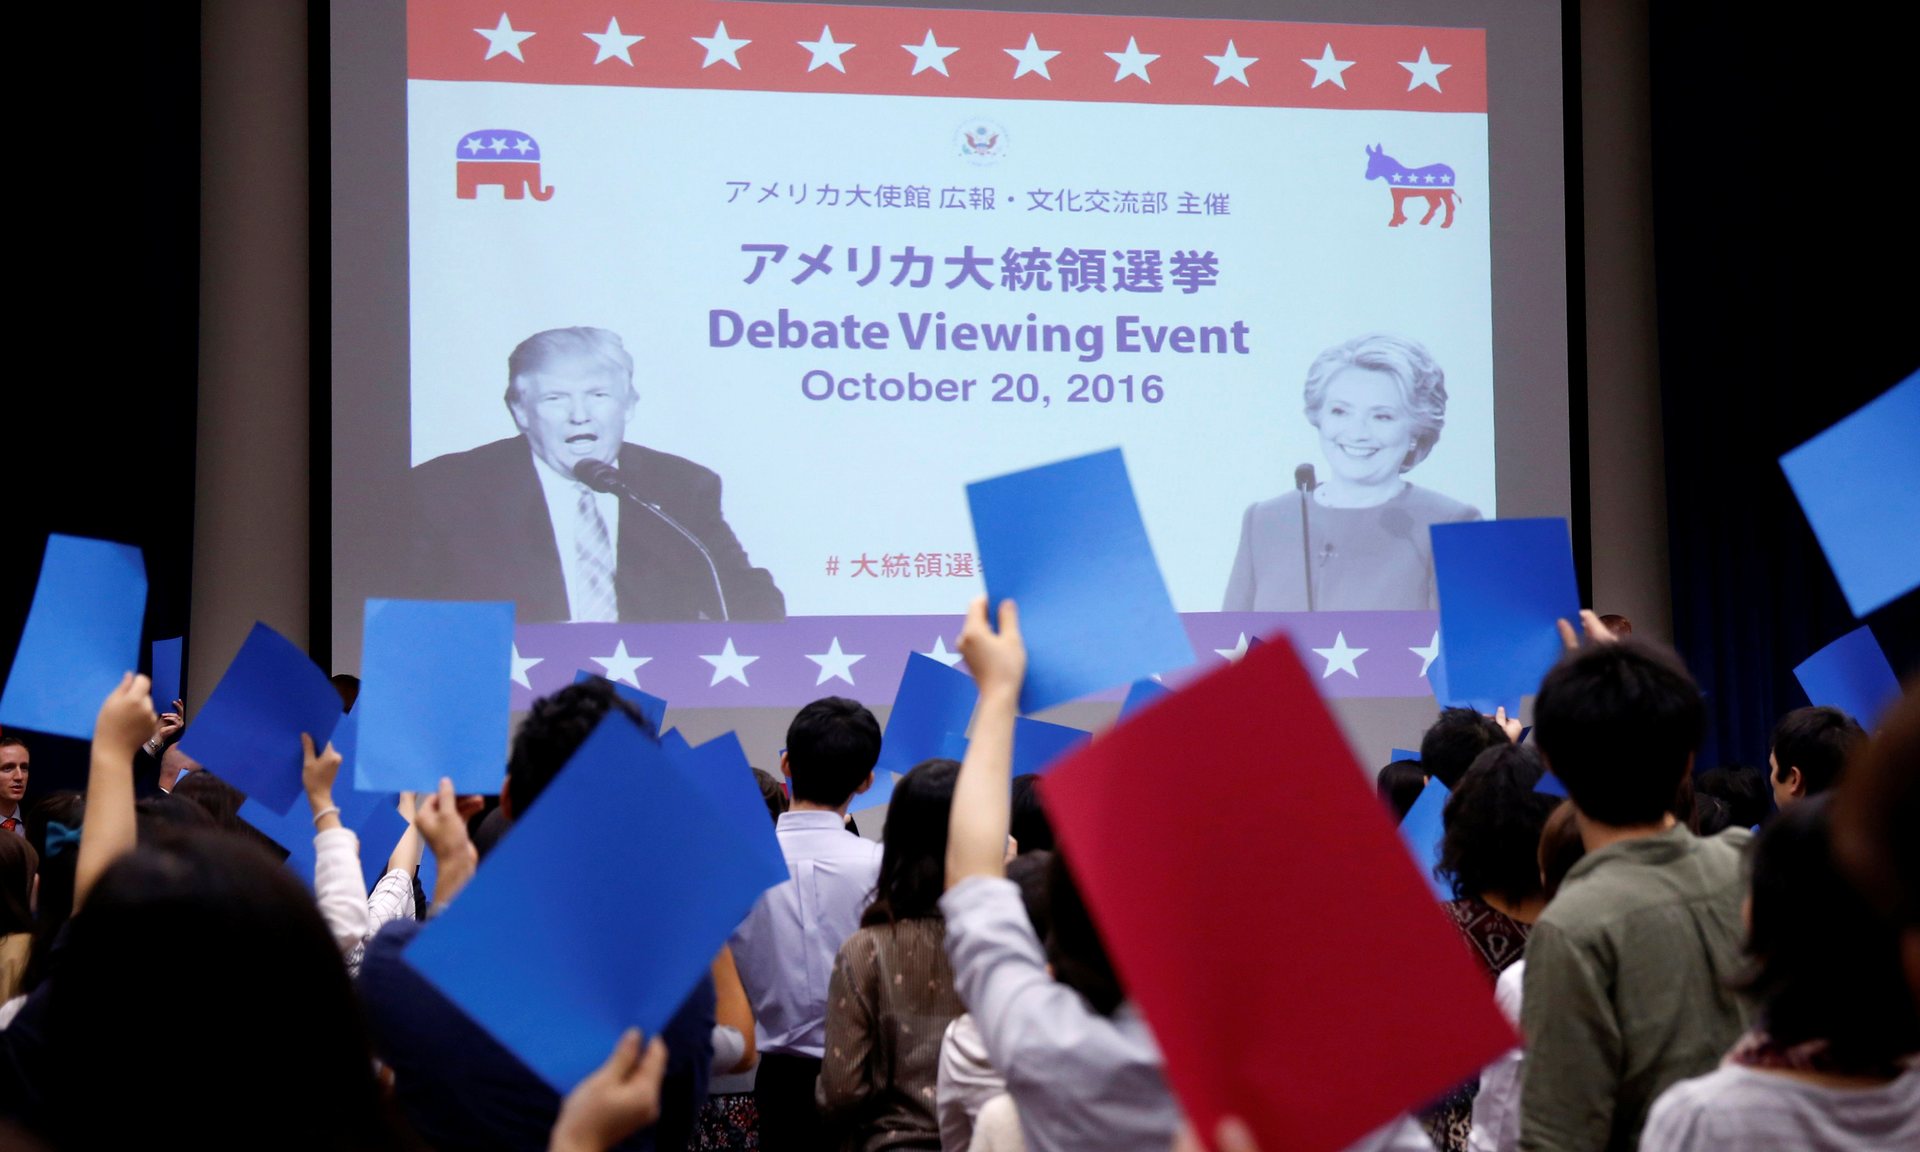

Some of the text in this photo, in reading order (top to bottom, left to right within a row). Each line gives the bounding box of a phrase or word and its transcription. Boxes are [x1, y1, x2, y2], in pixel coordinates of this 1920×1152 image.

[725, 181, 1231, 216] アメリカ大使館 広報・文化交流部 主催
[741, 244, 1221, 295] アメリカ大統領選挙
[708, 307, 1251, 363] Debate Viewing Event
[801, 369, 1165, 409] October 20, 2016
[851, 552, 982, 578] 大統領選
